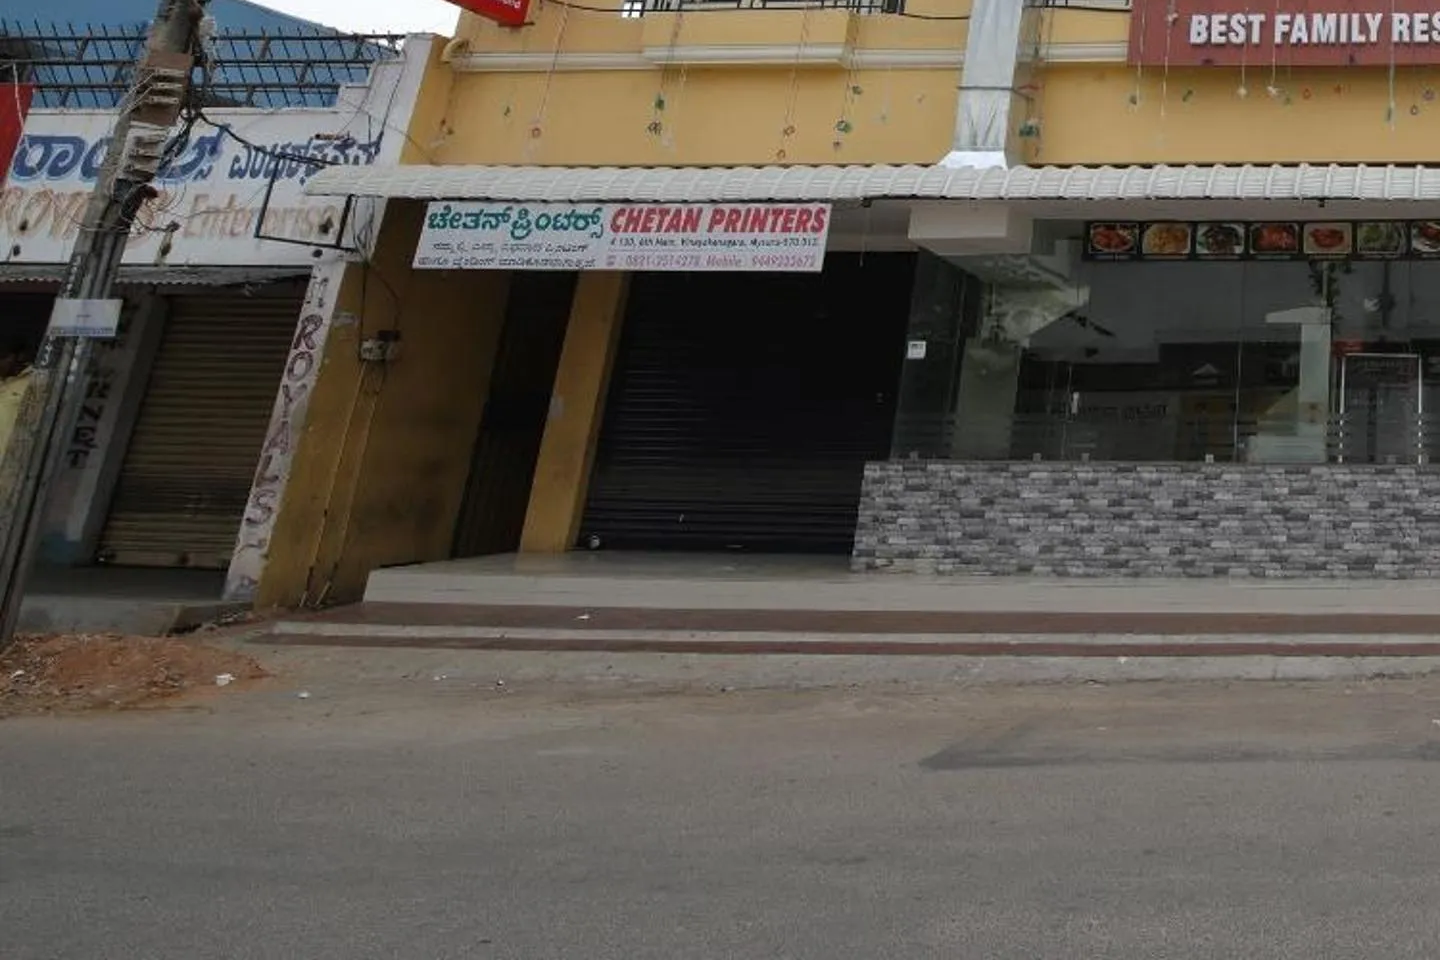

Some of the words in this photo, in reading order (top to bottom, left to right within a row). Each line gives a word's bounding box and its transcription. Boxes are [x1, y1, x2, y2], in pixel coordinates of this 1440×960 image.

[1189, 13, 1265, 45] BEST
[1273, 12, 1384, 44] FAMILY
[609, 207, 703, 233] CHETAN
[707, 207, 826, 233] PRINTERS
